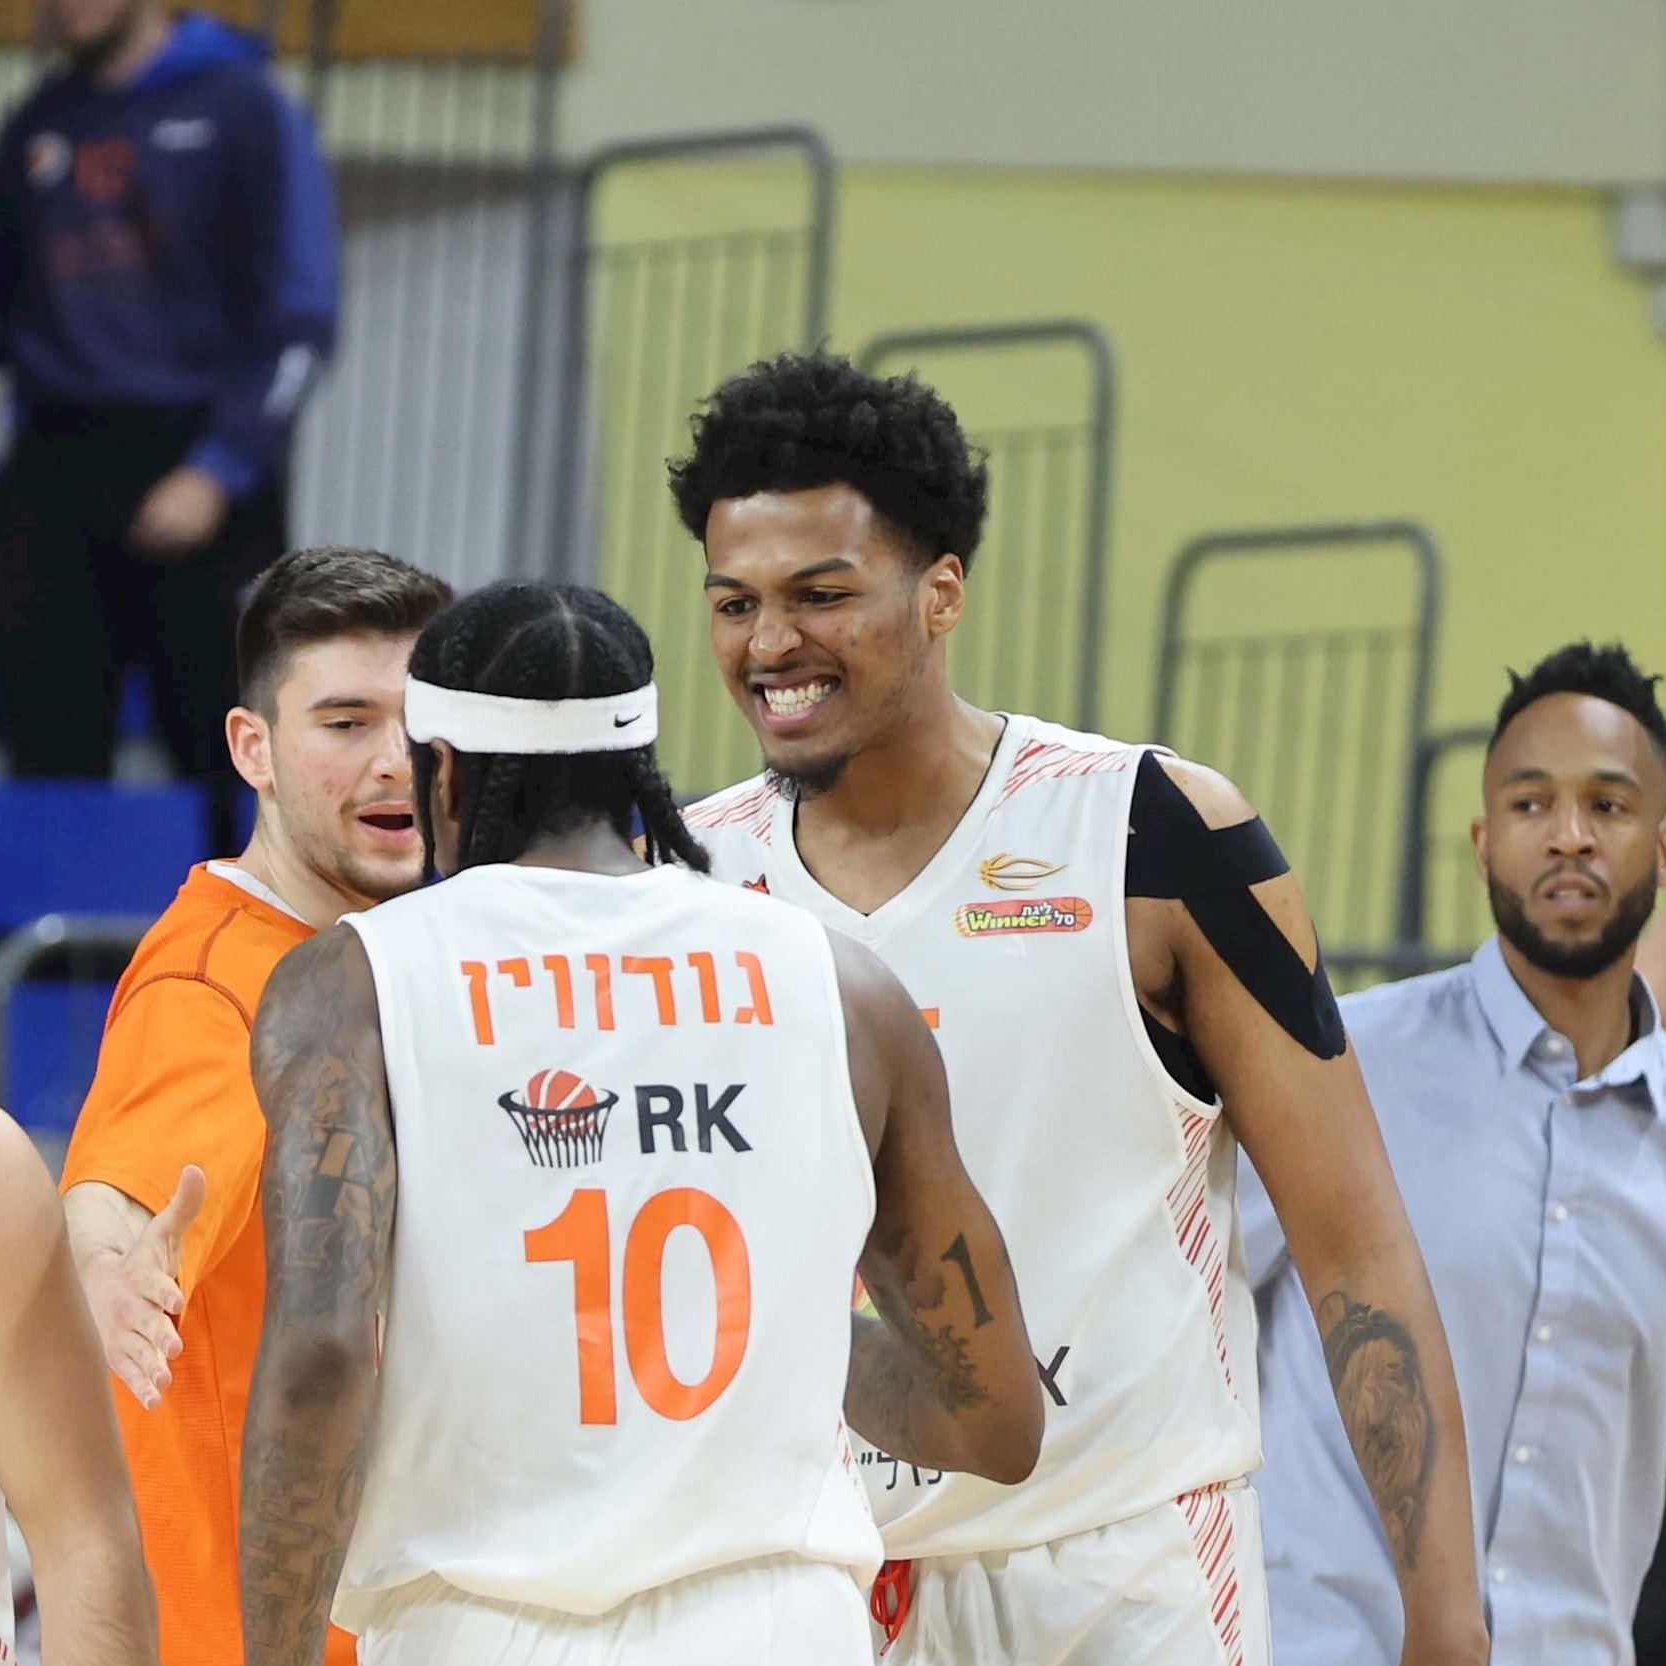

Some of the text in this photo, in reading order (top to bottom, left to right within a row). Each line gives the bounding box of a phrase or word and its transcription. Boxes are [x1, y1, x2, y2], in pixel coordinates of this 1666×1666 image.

[967, 910, 1076, 932] Winner סל
[1021, 901, 1053, 917] ליגת
[460, 951, 775, 1046] גודווין
[634, 1082, 754, 1155] RK
[522, 1186, 752, 1426] 10
